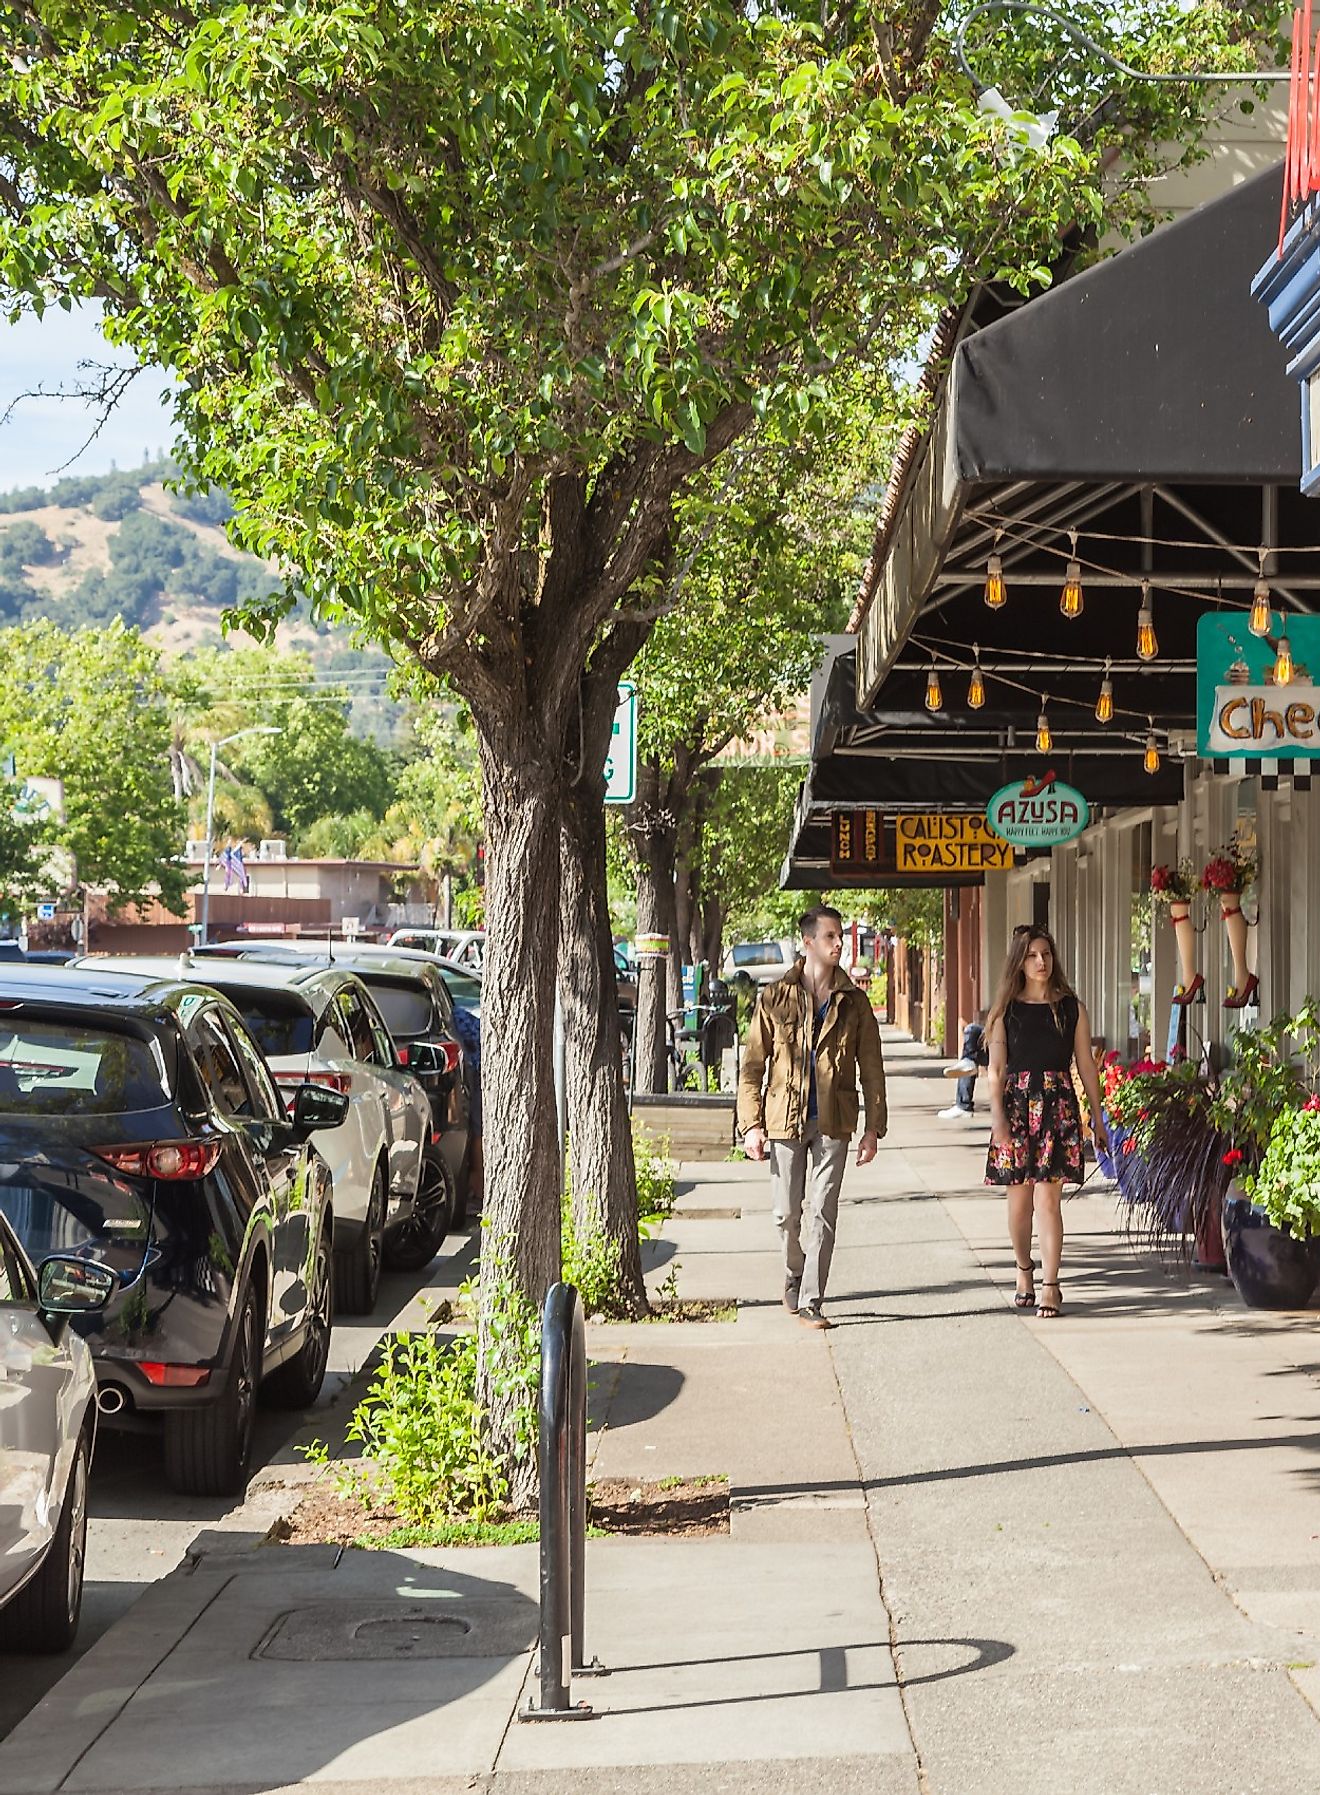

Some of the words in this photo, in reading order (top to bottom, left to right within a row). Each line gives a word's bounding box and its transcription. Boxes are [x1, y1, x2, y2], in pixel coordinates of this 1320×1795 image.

[997, 800, 1079, 824] AZUSA
[899, 816, 1000, 839] CALISTOG
[903, 843, 1009, 866] ROASTERY
